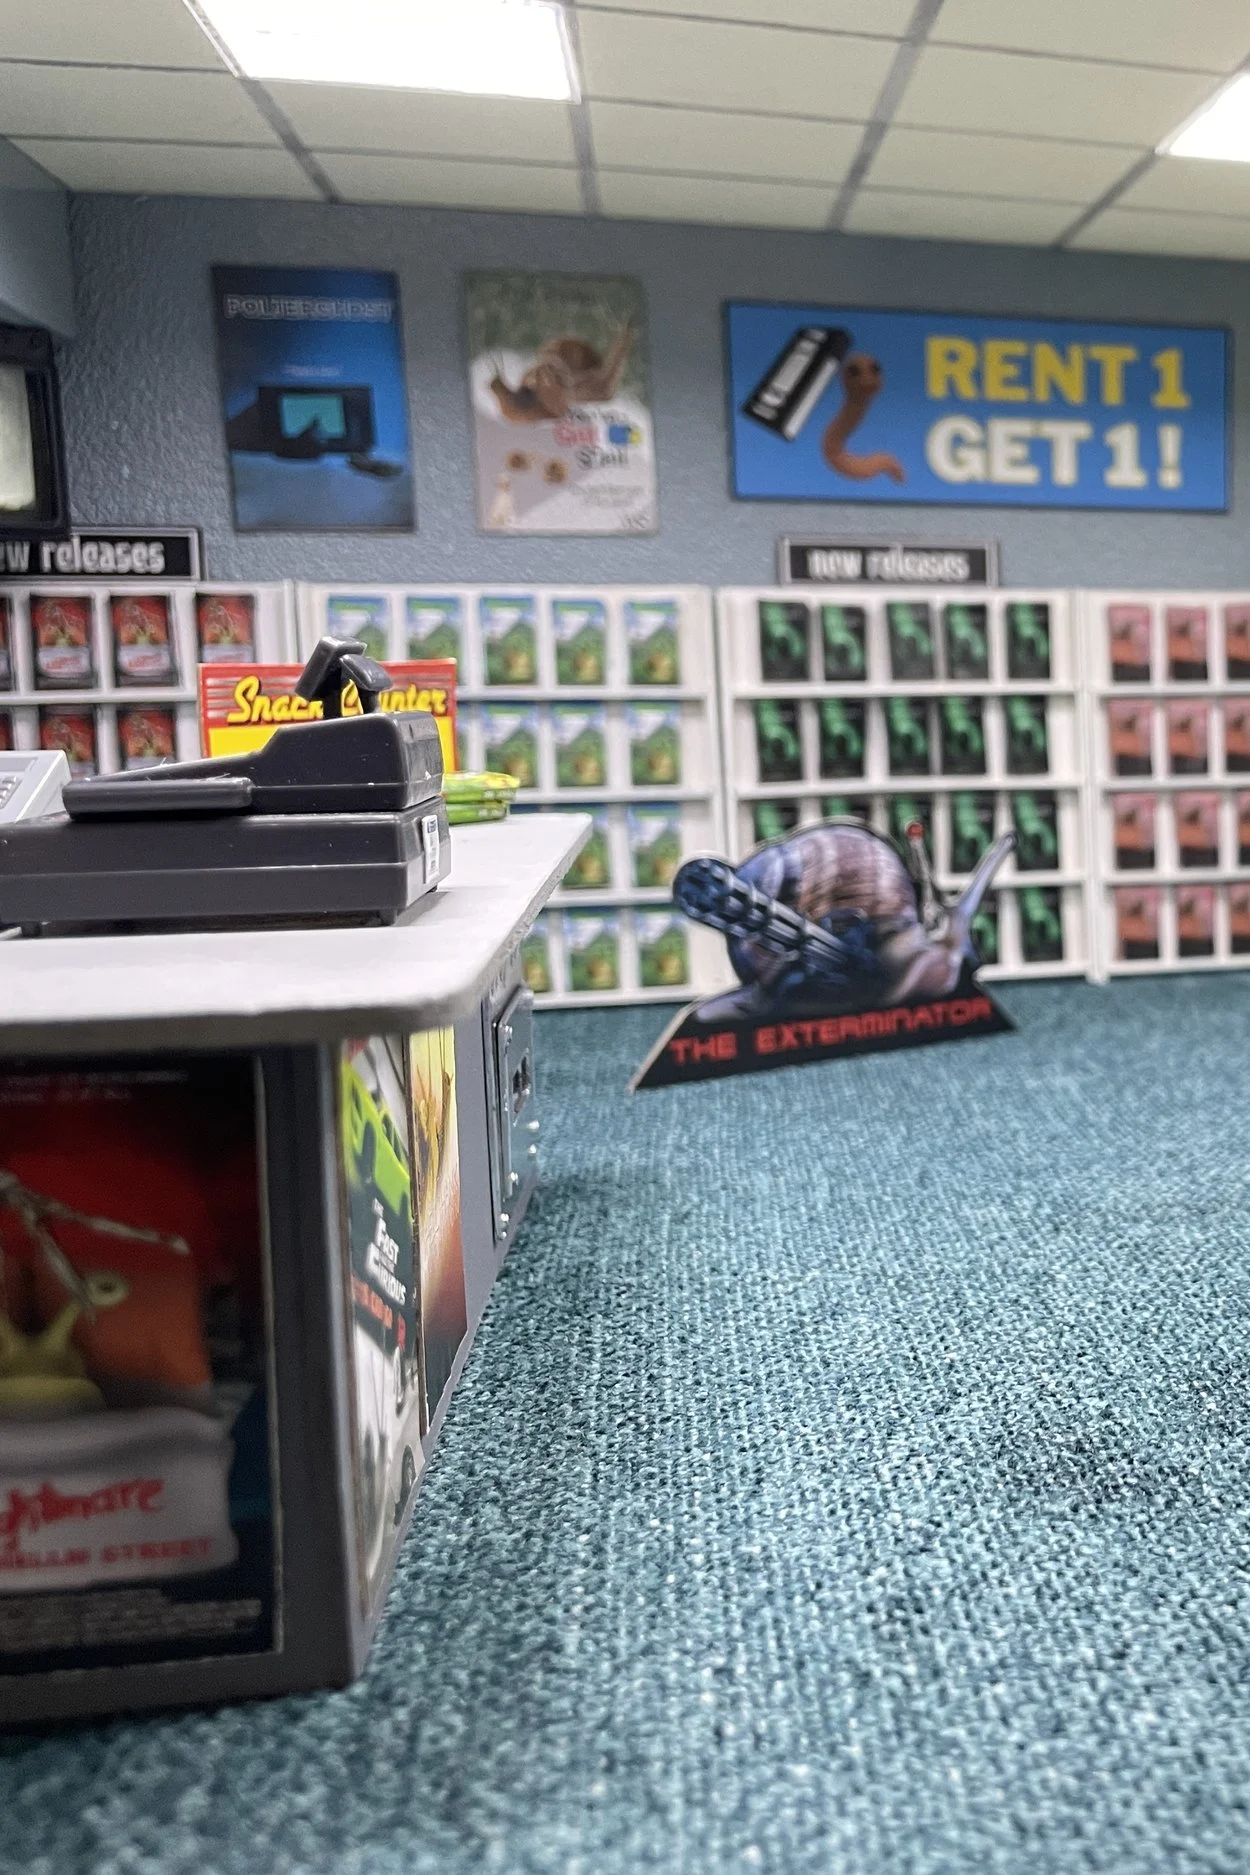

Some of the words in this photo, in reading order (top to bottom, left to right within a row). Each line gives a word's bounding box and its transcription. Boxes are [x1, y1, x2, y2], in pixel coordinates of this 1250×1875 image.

[924, 335, 1138, 405] RENT
[1152, 348, 1191, 409] 1
[925, 415, 1092, 486] GET
[1103, 421, 1183, 490] 1!
[40, 537, 166, 574] releases
[806, 548, 862, 581] new
[866, 544, 970, 582] releases
[668, 1033, 738, 1065] THE
[754, 996, 993, 1056] EXTERMINATOR
